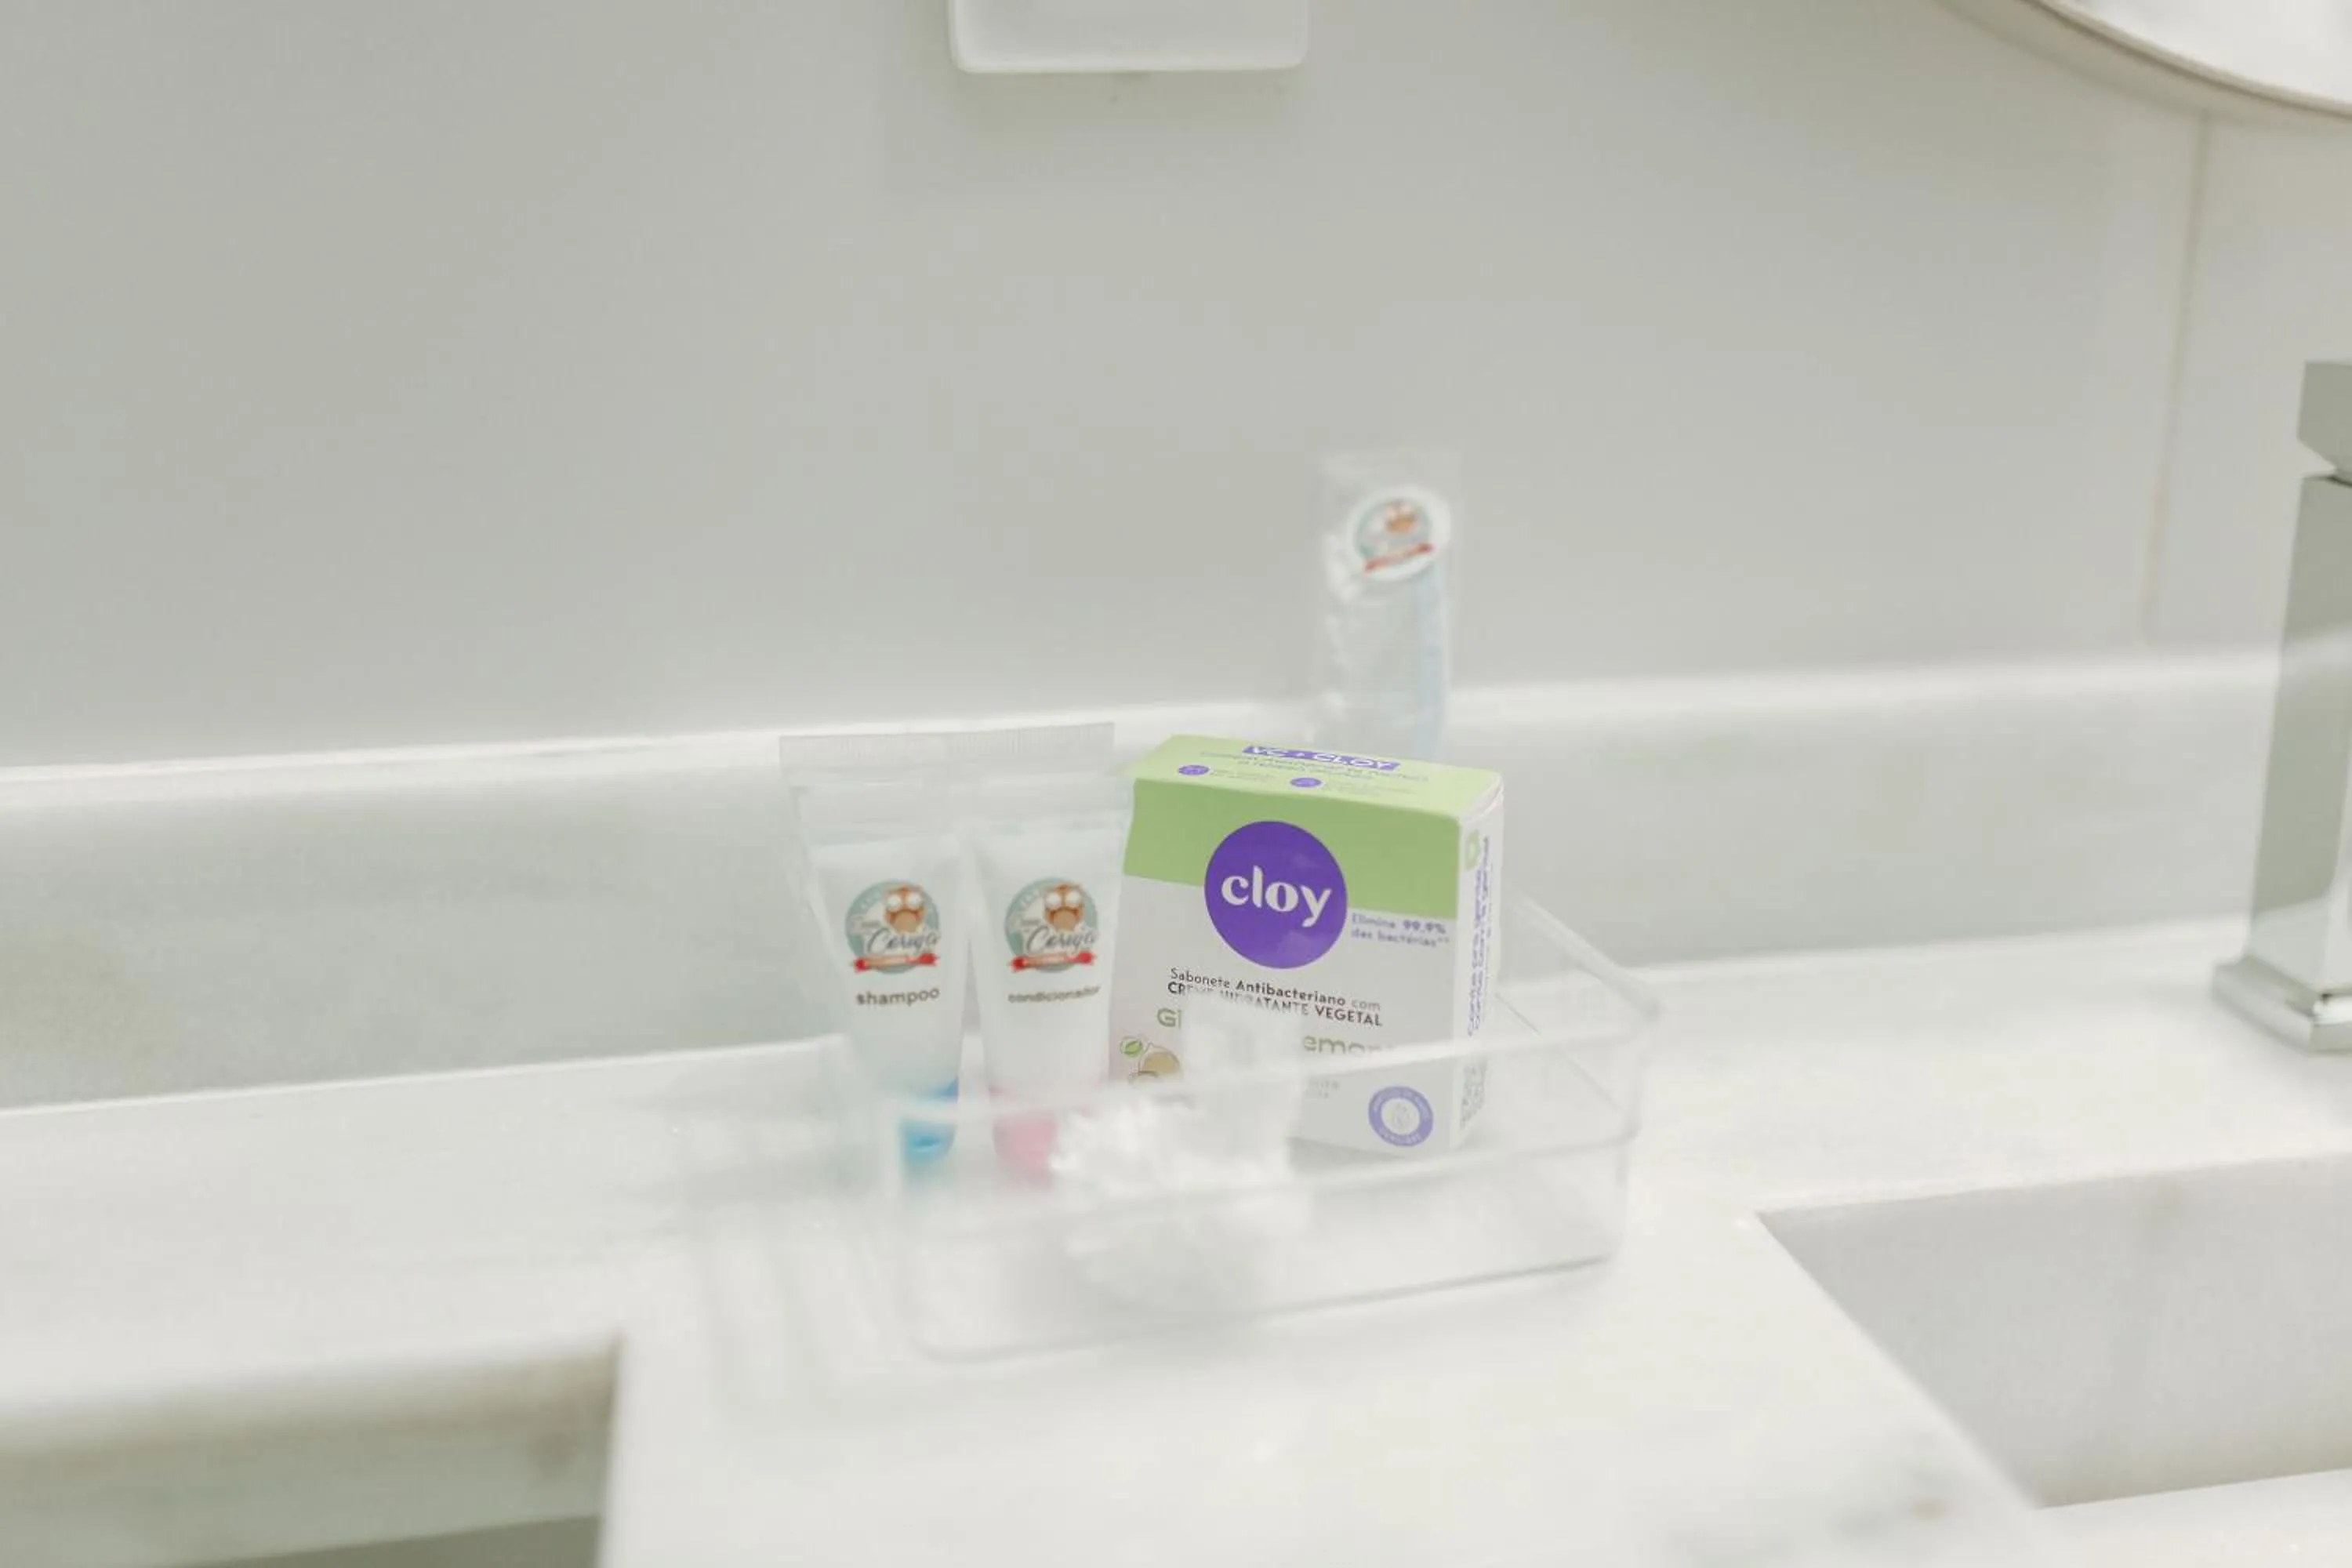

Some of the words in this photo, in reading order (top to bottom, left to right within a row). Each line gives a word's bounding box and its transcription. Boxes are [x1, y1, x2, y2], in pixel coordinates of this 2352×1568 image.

[1312, 753, 1393, 770] CLOY
[1221, 865, 1332, 928] cloy
[856, 987, 940, 1007] shampoo
[1171, 967, 1231, 989] Sabonete
[1235, 980, 1346, 1007] Antibacteriano
[1351, 999, 1381, 1011] com
[1315, 1005, 1383, 1027] VEGETAL
